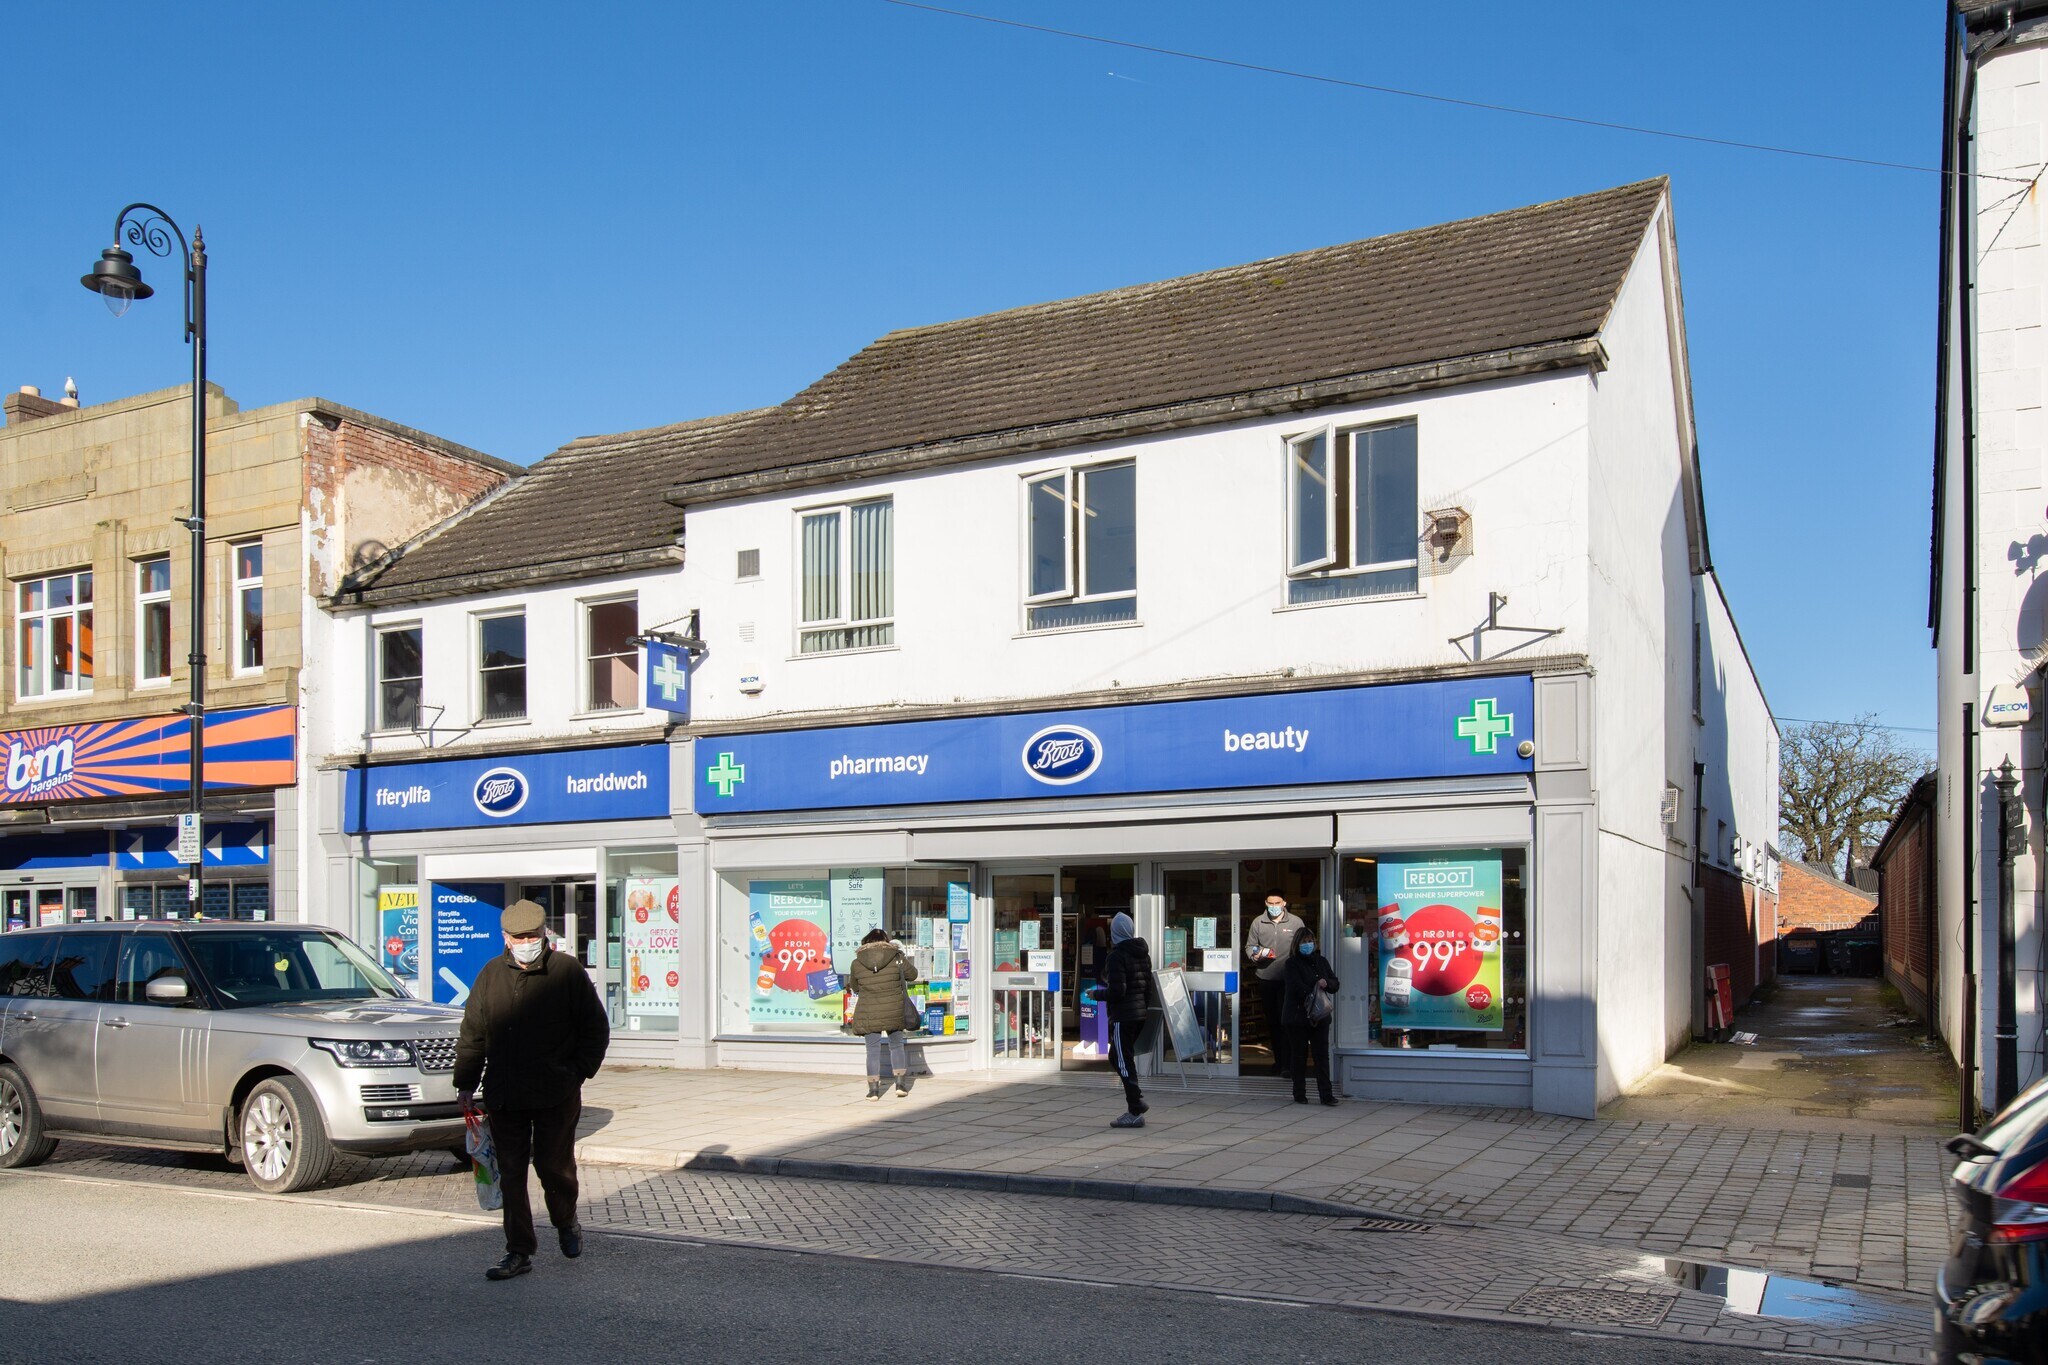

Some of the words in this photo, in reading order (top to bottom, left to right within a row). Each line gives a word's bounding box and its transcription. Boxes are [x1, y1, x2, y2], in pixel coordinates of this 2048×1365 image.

[1992, 702, 2028, 713] SECOM
[1224, 725, 1309, 753] beauty
[1032, 738, 1084, 770] Boots
[7, 739, 74, 791] b&m
[830, 754, 929, 780] pharmacy
[30, 771, 74, 794] bargains
[567, 770, 648, 794] harddwch
[376, 785, 431, 808] fferyllfa
[480, 778, 515, 806] Boots
[848, 874, 864, 883] Shop
[1409, 871, 1468, 885] REBOOT
[437, 895, 478, 904] croeso
[773, 894, 819, 905] REBOOT
[1437, 890, 1485, 898] SUPERPOWER
[398, 926, 418, 935] Con
[1422, 930, 1455, 938] FROM
[649, 937, 678, 948] LOVE
[784, 940, 811, 948] FROM
[438, 947, 463, 955] trydanol
[1412, 940, 1467, 972] 99P
[777, 948, 816, 972] 99P
